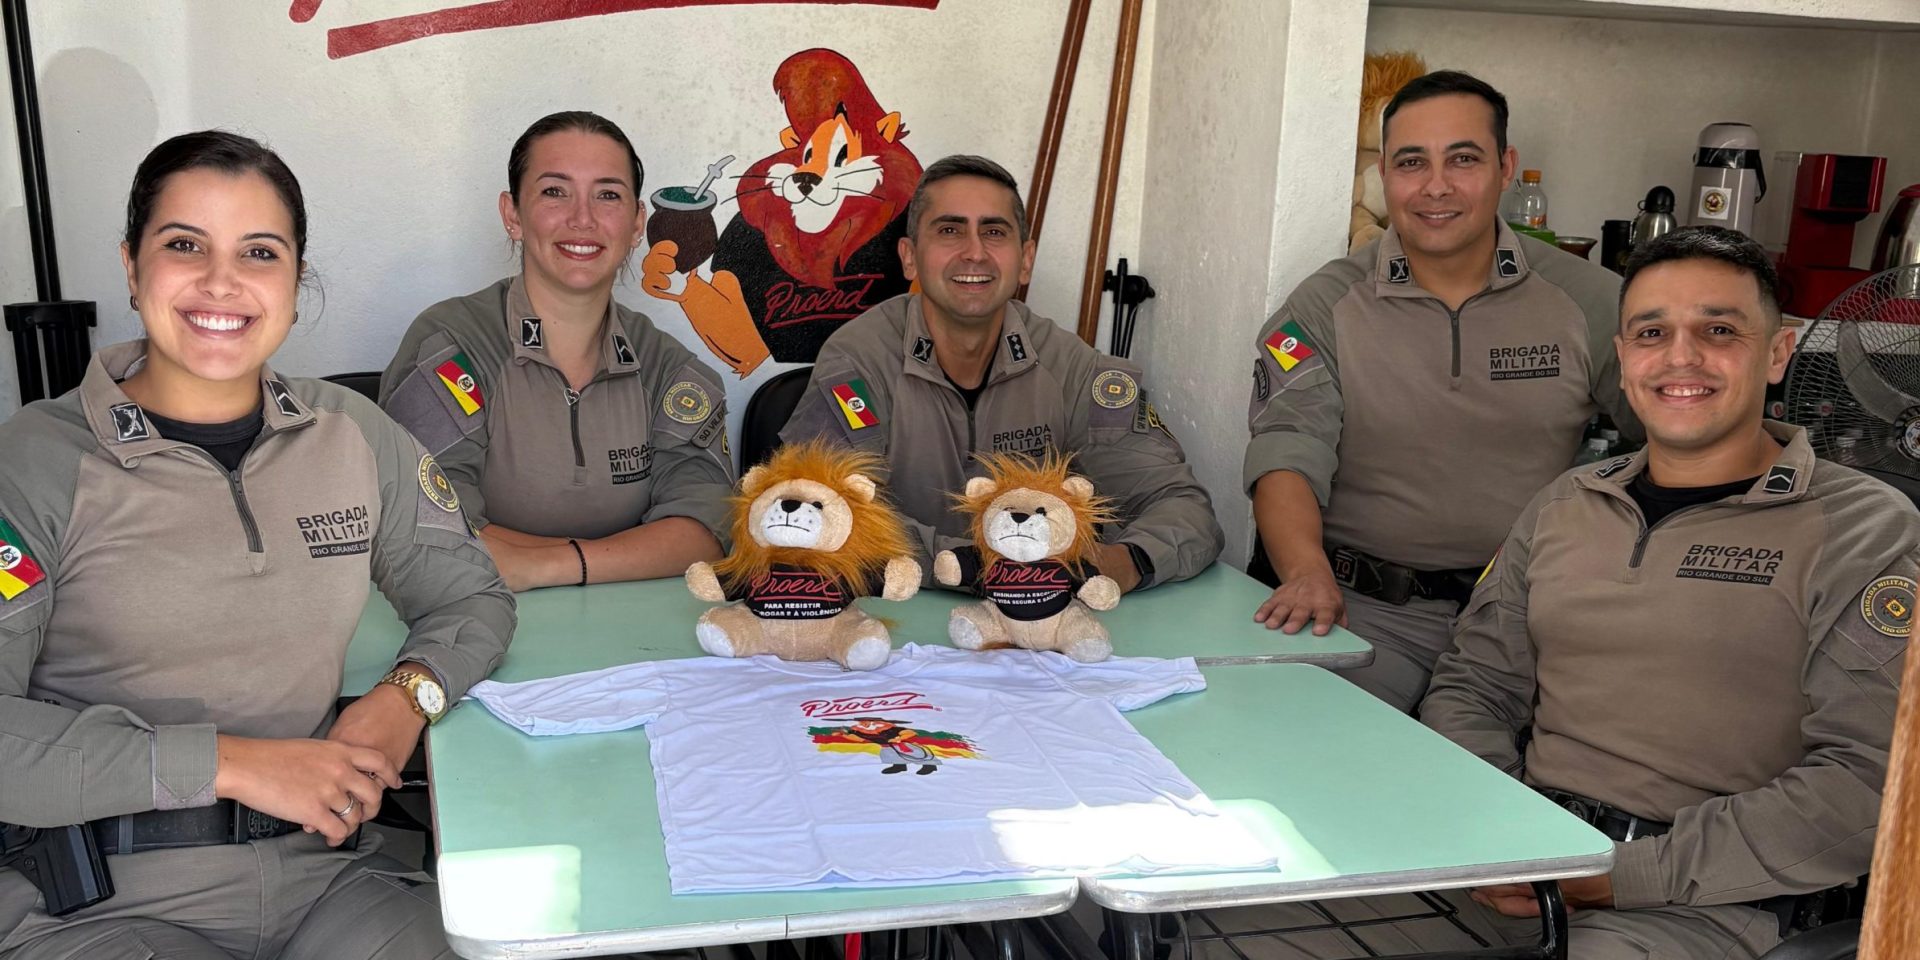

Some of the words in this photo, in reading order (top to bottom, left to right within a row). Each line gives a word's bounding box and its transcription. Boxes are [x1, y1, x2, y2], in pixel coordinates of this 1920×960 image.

[763, 279, 880, 325] Proerd
[1490, 343, 1560, 359] BRIGADA
[1490, 355, 1560, 370] MILITAR
[993, 423, 1051, 444] BRIGADA
[608, 444, 649, 461] BRIGA
[296, 504, 369, 529] BRIGADA
[301, 520, 370, 544] MILITAR
[311, 547, 329, 556] RIO
[330, 545, 360, 554] GRANDE
[1687, 544, 1784, 561] BRIGADA
[985, 562, 1069, 585] Proerd
[1680, 555, 1780, 575] MILITAR
[750, 570, 843, 598] Proerd
[1695, 571, 1735, 581] GRANDE
[1752, 576, 1770, 584] SUL
[992, 591, 1026, 599] ENSINANDO
[1864, 586, 1878, 617] BRIGADA
[1877, 579, 1909, 589] MILITAR
[800, 607, 842, 617] VIOLÊNCIA
[800, 695, 920, 718] Proerd
